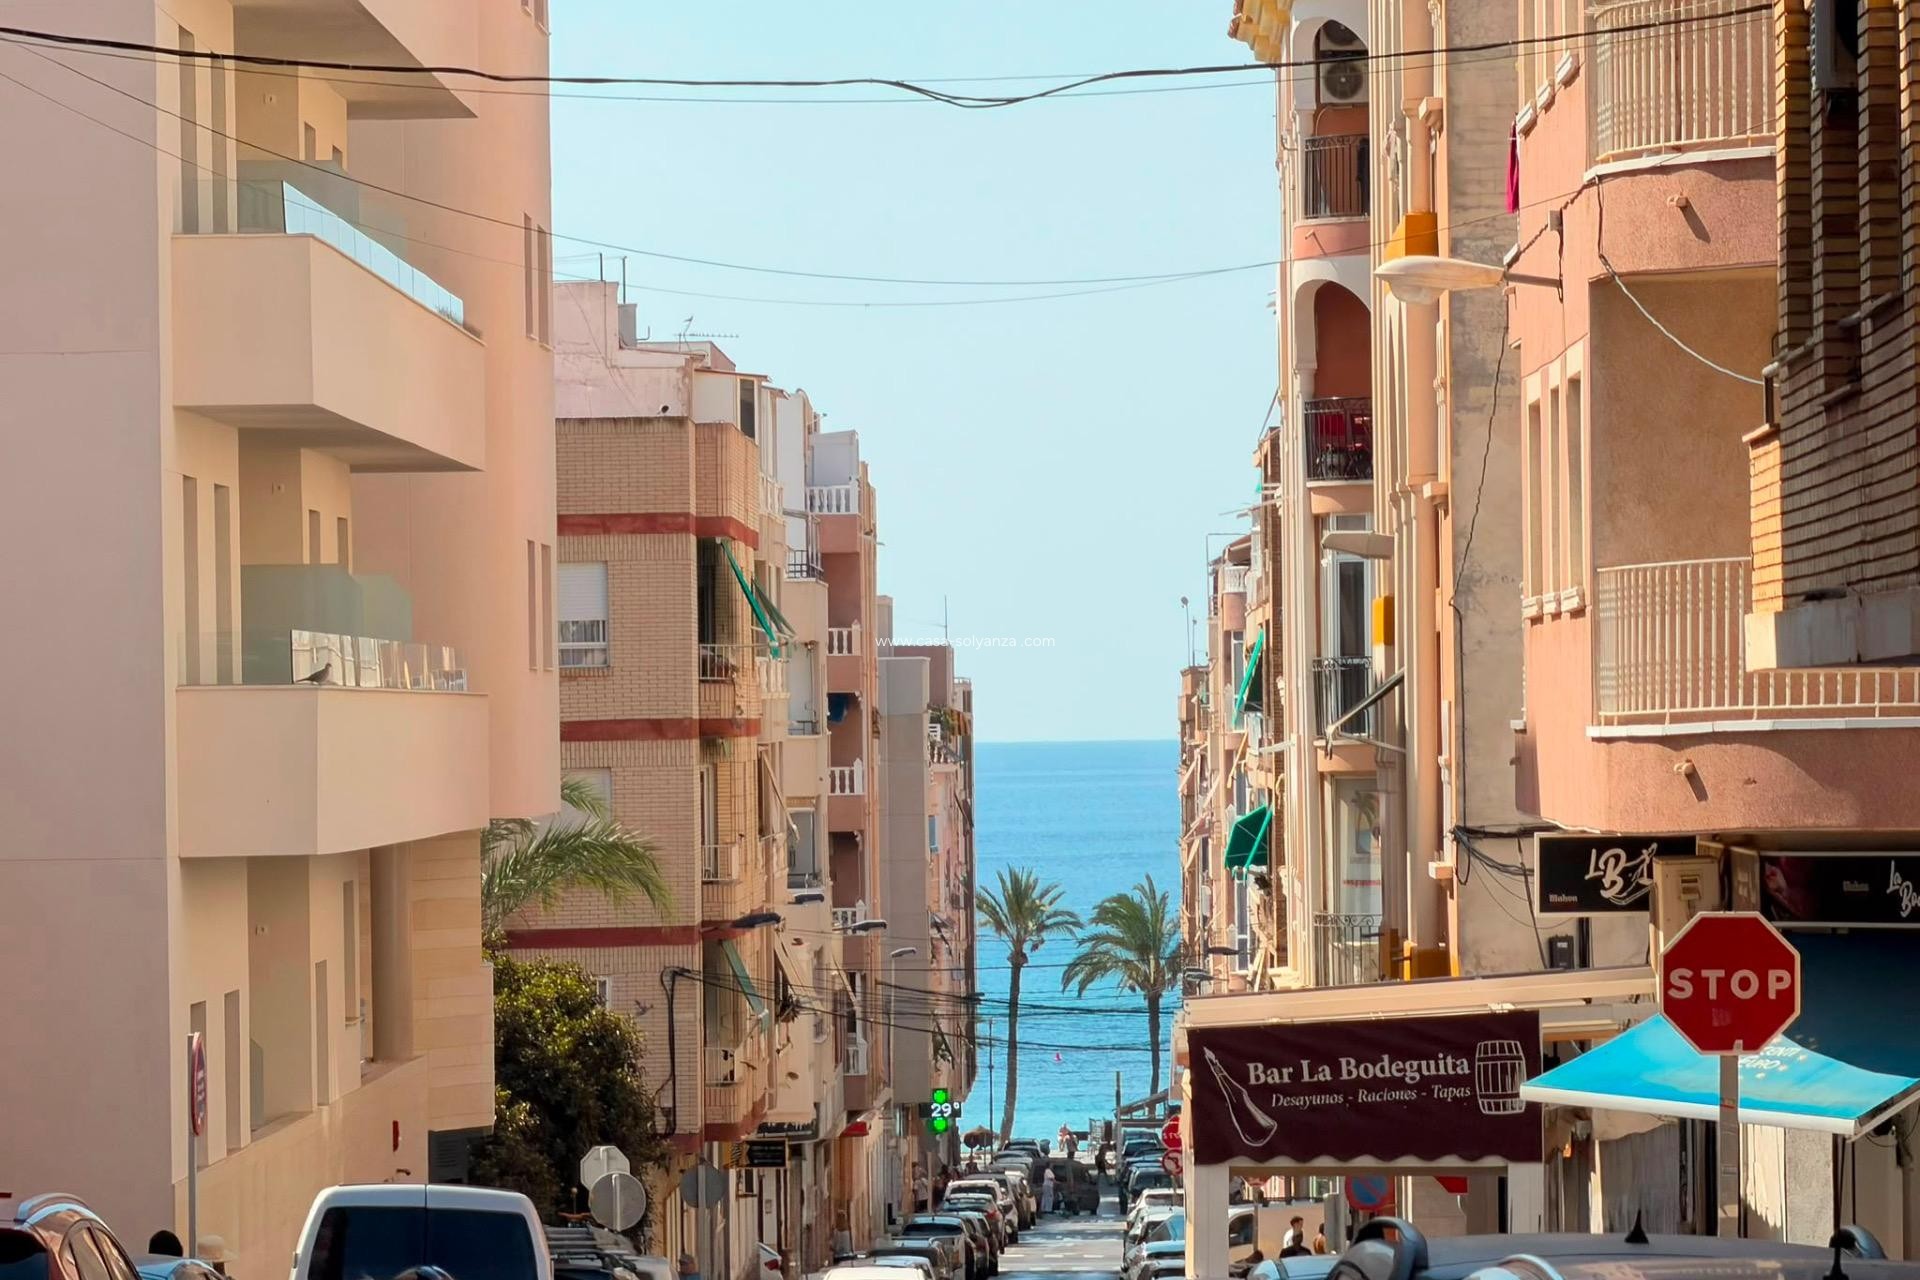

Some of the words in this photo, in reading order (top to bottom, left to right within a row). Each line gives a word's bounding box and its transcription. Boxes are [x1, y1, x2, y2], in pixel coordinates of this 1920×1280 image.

[1667, 967, 1792, 1000] STOP
[1246, 1062, 1294, 1085] Bar
[1300, 1059, 1333, 1083] La
[1338, 1052, 1471, 1084] Bodeguita
[1271, 1093, 1344, 1110] Desayunos
[1357, 1088, 1418, 1103] Raciones
[1431, 1084, 1472, 1102] Tapas
